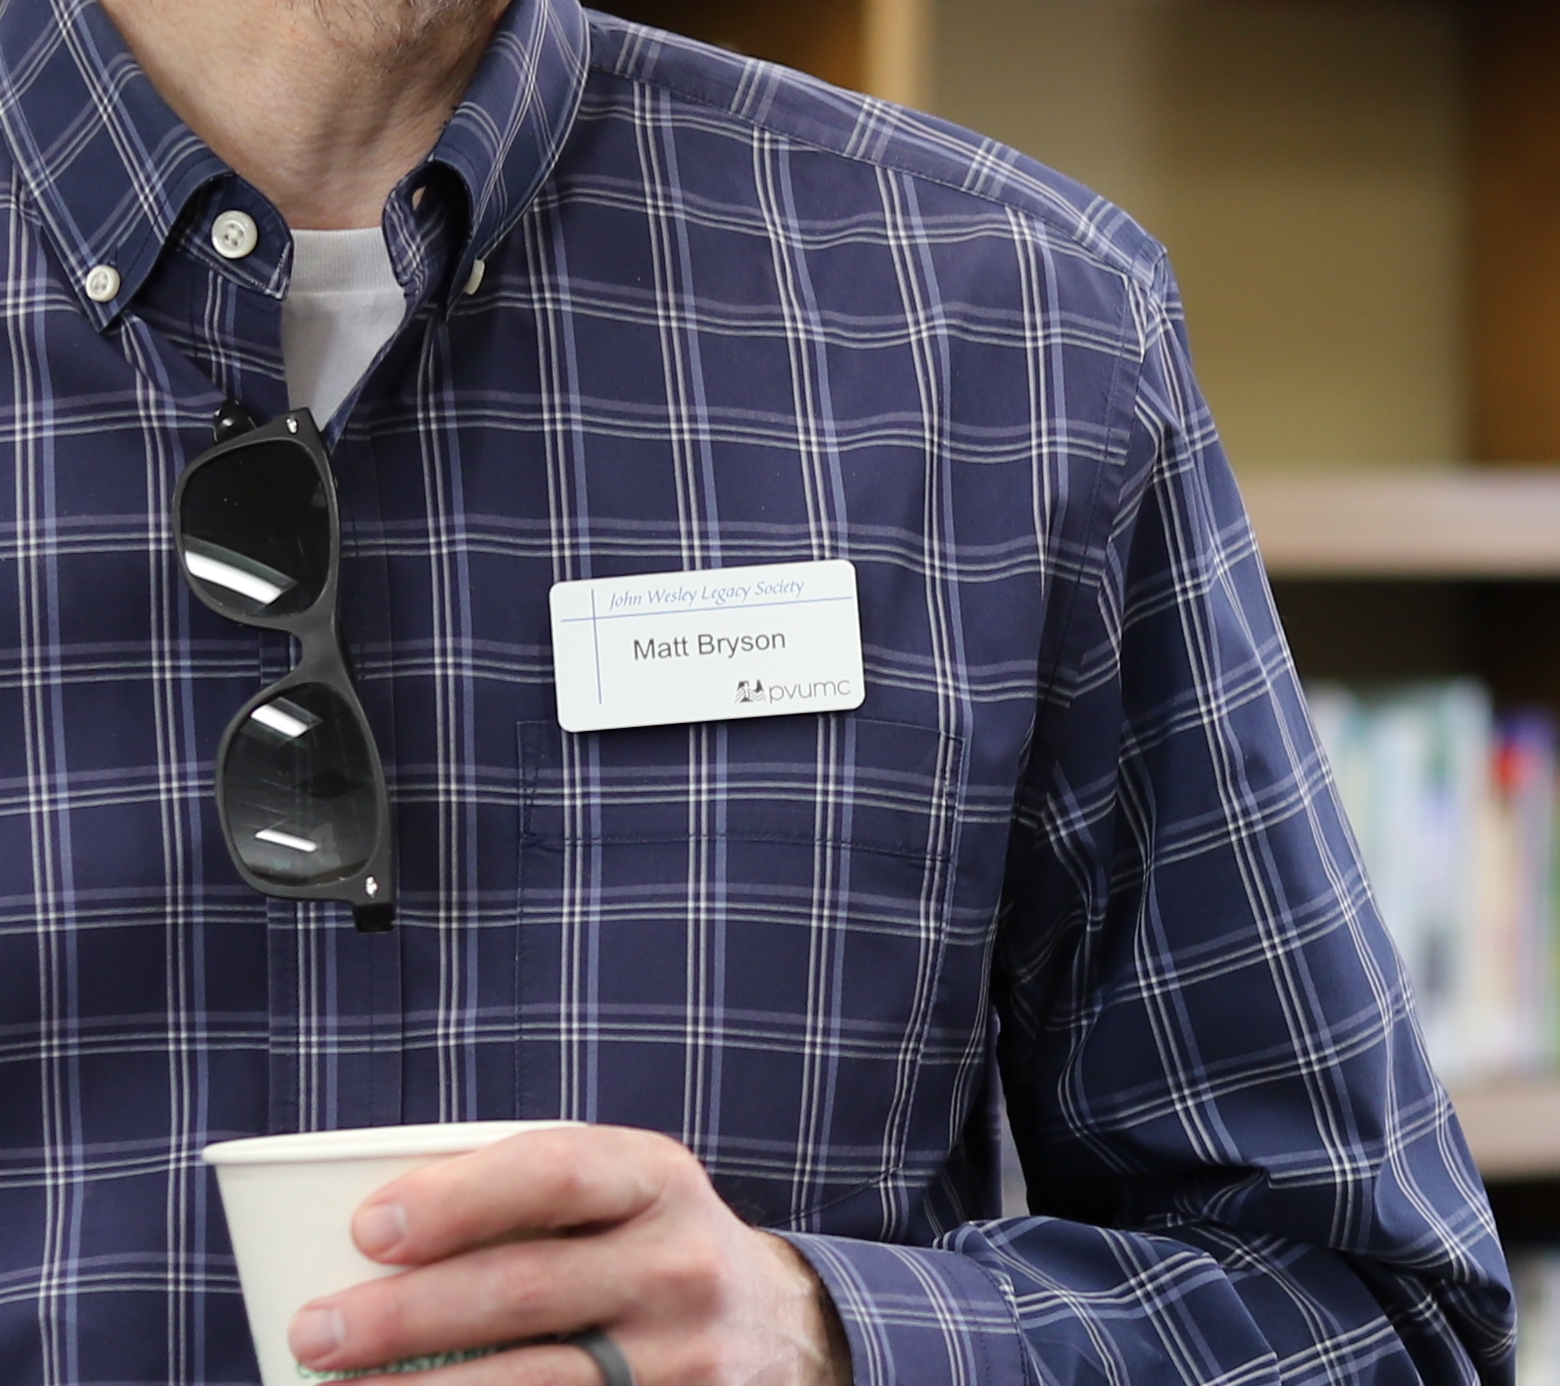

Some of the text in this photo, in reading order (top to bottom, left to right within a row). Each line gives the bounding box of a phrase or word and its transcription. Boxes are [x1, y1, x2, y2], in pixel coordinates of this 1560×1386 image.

[609, 579, 805, 610] John Wesley Legacy Society
[633, 632, 786, 661] Matt Bryson
[769, 679, 852, 704] pvumc
